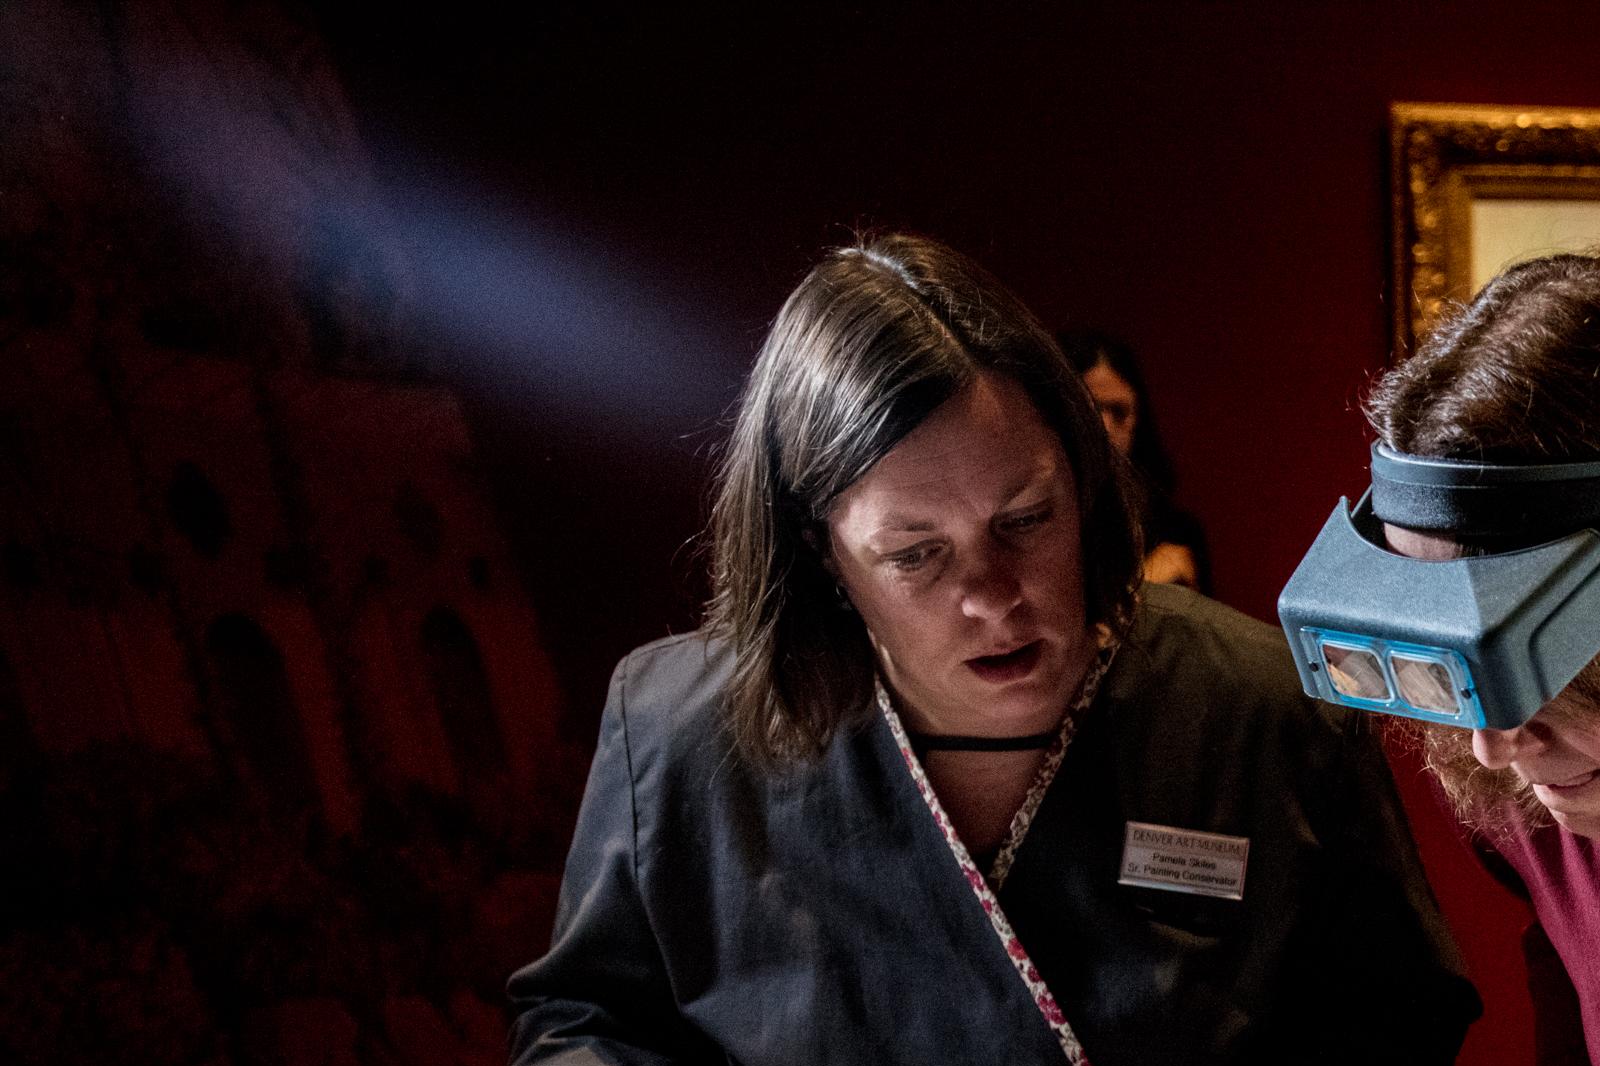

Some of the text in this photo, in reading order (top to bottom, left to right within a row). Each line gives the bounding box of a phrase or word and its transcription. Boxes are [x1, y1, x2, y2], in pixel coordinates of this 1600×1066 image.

[1133, 830, 1173, 845] DENVER
[1176, 835, 1195, 849] ART
[1144, 866, 1180, 880] Painting
[1182, 870, 1237, 887] Conservator
